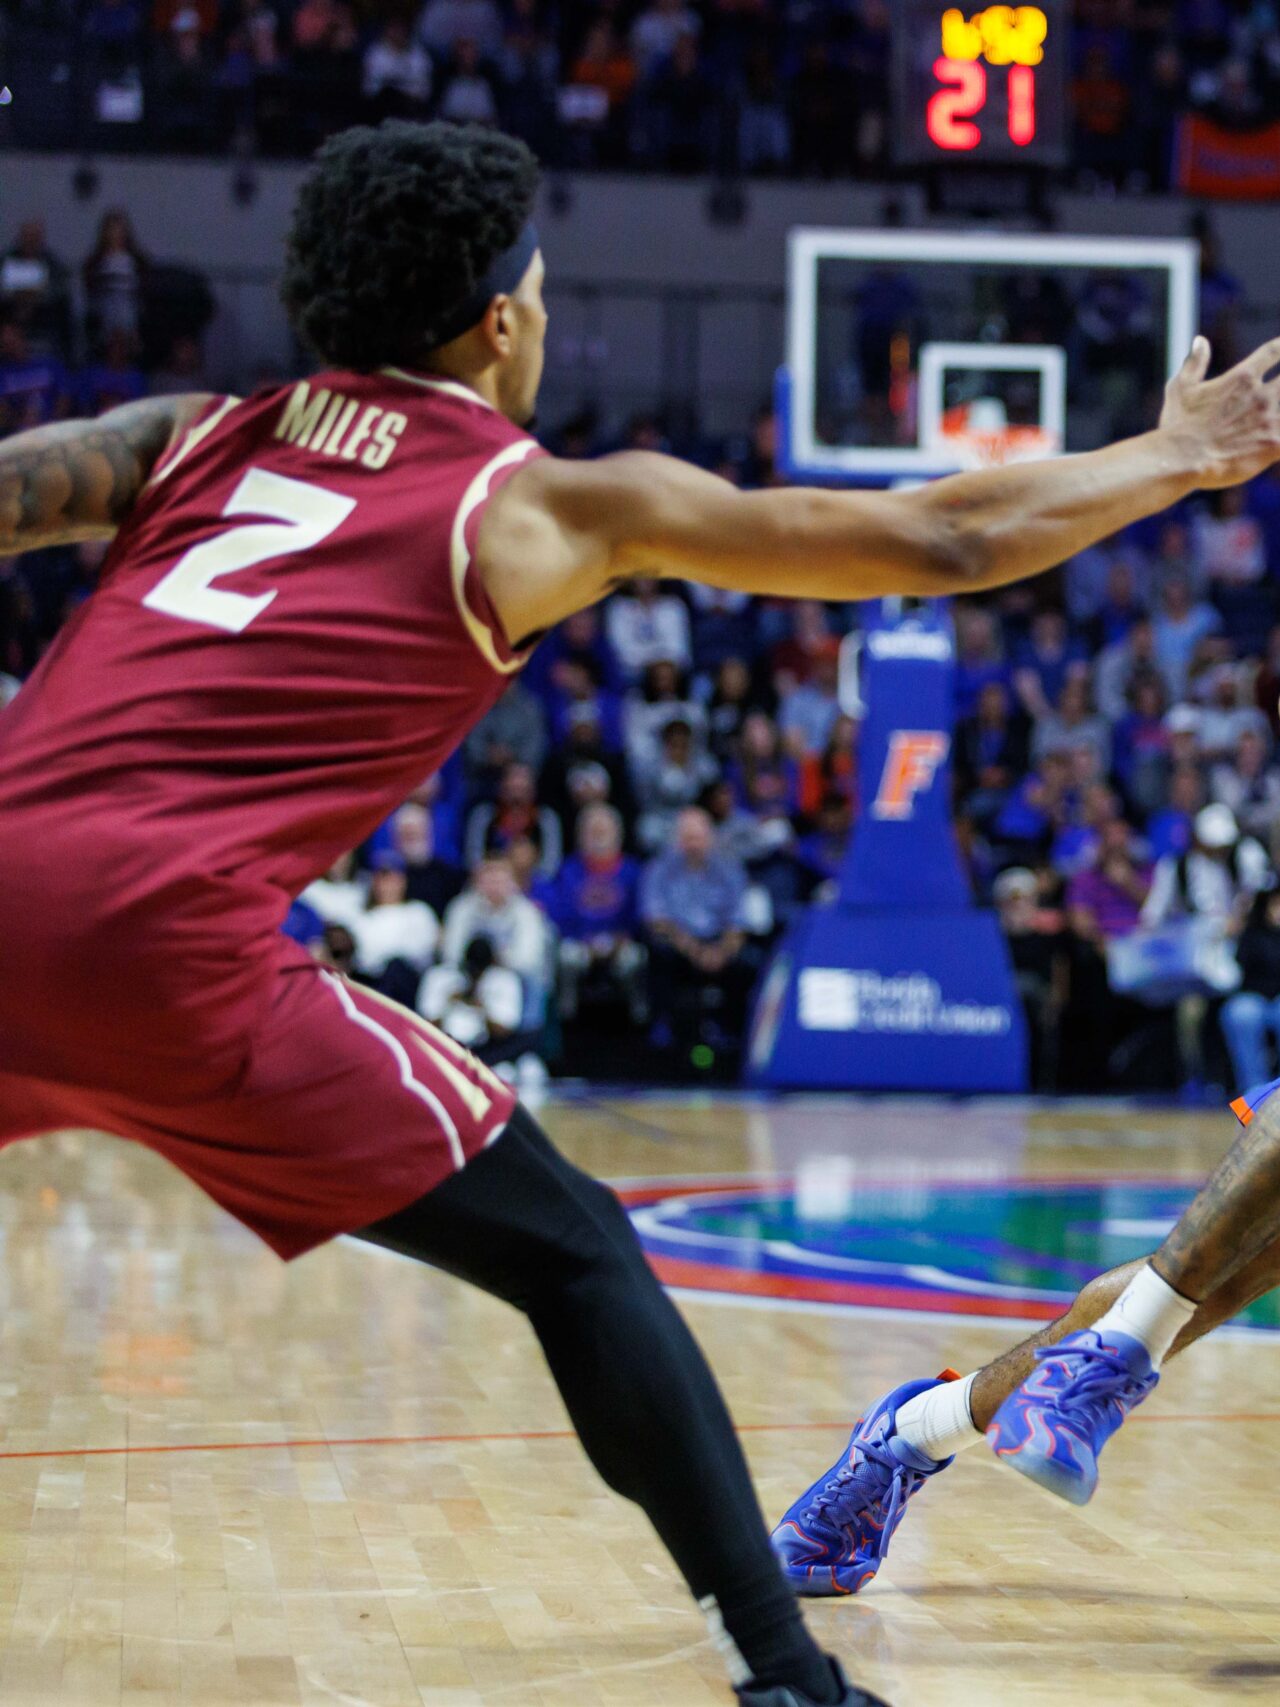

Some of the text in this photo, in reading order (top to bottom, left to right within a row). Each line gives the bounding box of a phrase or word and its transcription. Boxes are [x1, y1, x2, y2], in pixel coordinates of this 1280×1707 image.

[927, 56, 1035, 150] 21
[274, 380, 407, 470] MILES
[142, 466, 358, 634] 2
[872, 730, 950, 820] F
